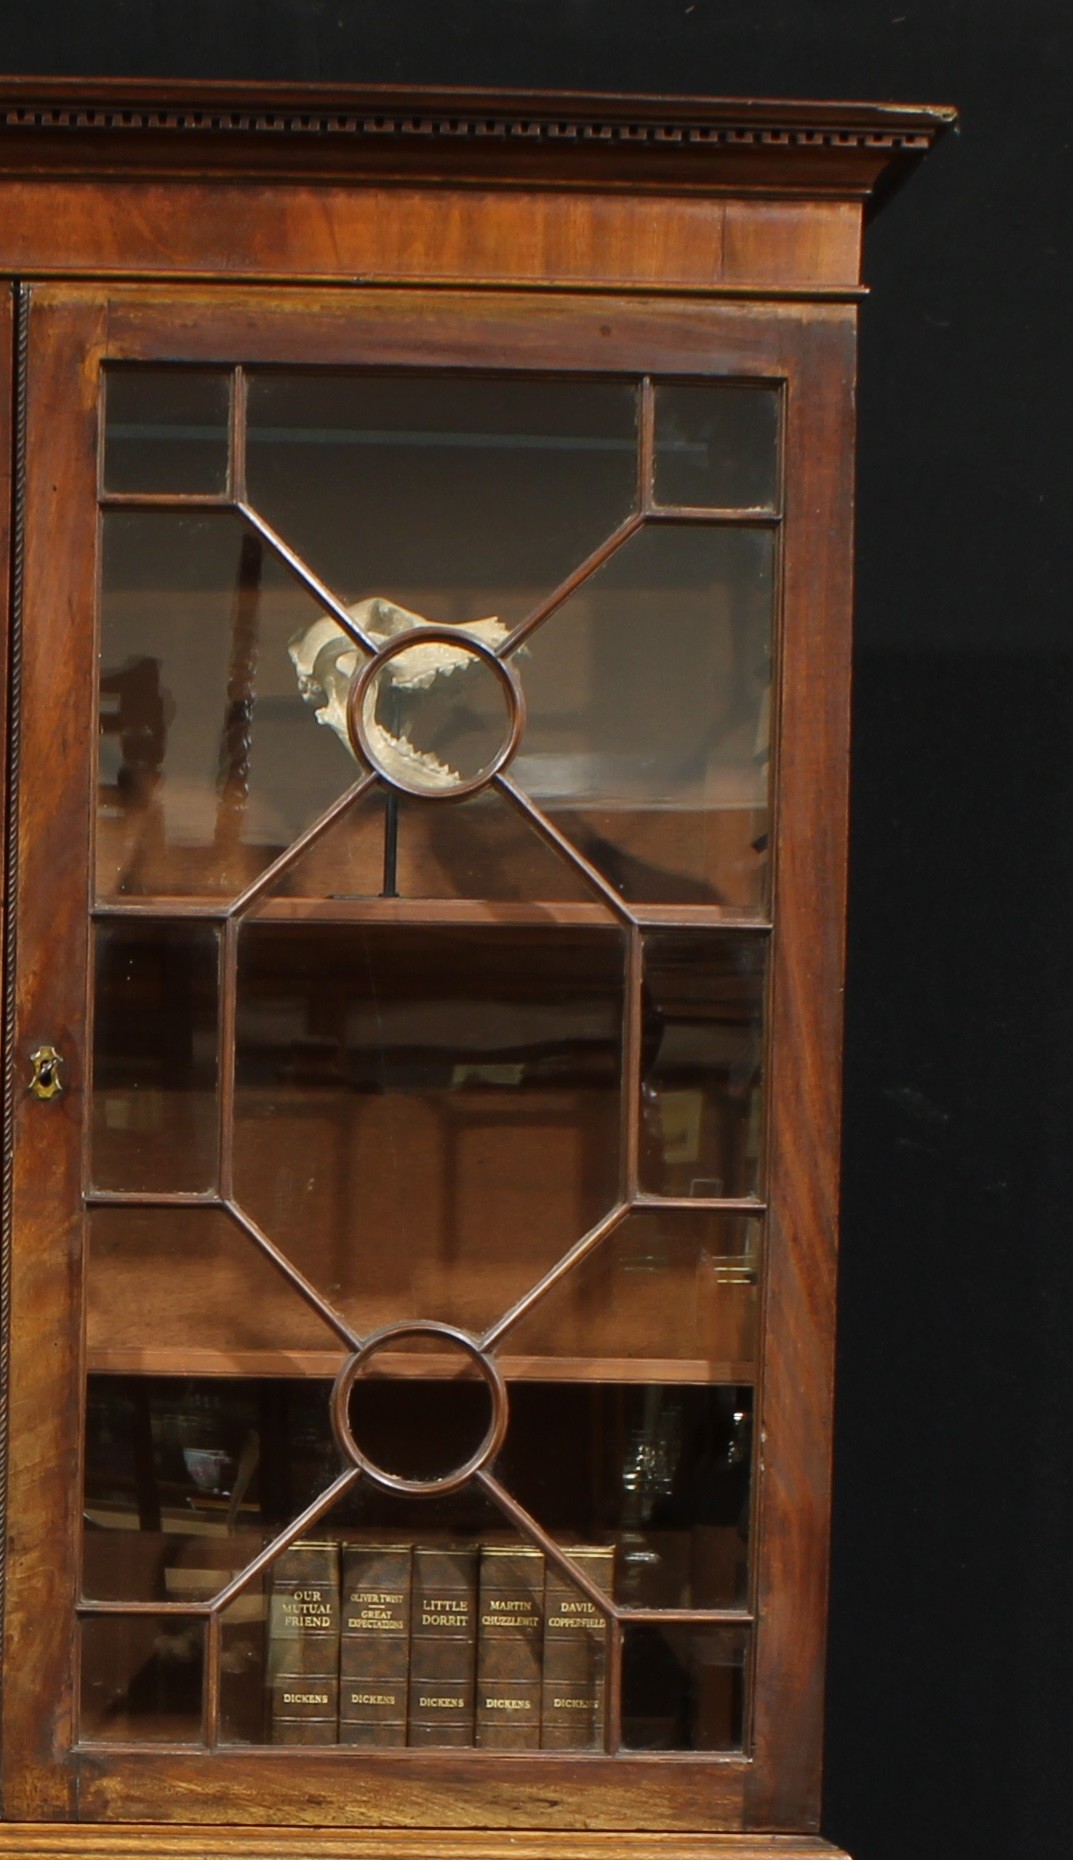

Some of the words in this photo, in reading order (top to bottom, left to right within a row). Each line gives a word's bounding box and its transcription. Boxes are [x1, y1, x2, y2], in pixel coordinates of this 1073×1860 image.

[293, 1591, 322, 1601] OUR
[350, 1593, 378, 1603] OLIVER
[380, 1594, 403, 1603] TWIST
[282, 1603, 333, 1614] MUTUAL
[423, 1600, 468, 1612] LITTLE
[489, 1600, 532, 1611] MARTIN
[560, 1602, 595, 1613] DAVID
[361, 1610, 392, 1619] GREAT
[285, 1616, 330, 1627] FRIEND
[348, 1619, 403, 1629] EXPECTATIONS
[422, 1615, 468, 1626] DORRIT
[481, 1616, 539, 1626] CHUZZLEWIT
[548, 1617, 606, 1628] COPPERFIELD
[283, 1694, 328, 1703] DICKENS
[351, 1694, 395, 1704] DICKENS
[419, 1697, 464, 1708] DICKENS
[486, 1698, 531, 1709] DICKENS
[553, 1698, 599, 1709] DICKENS
